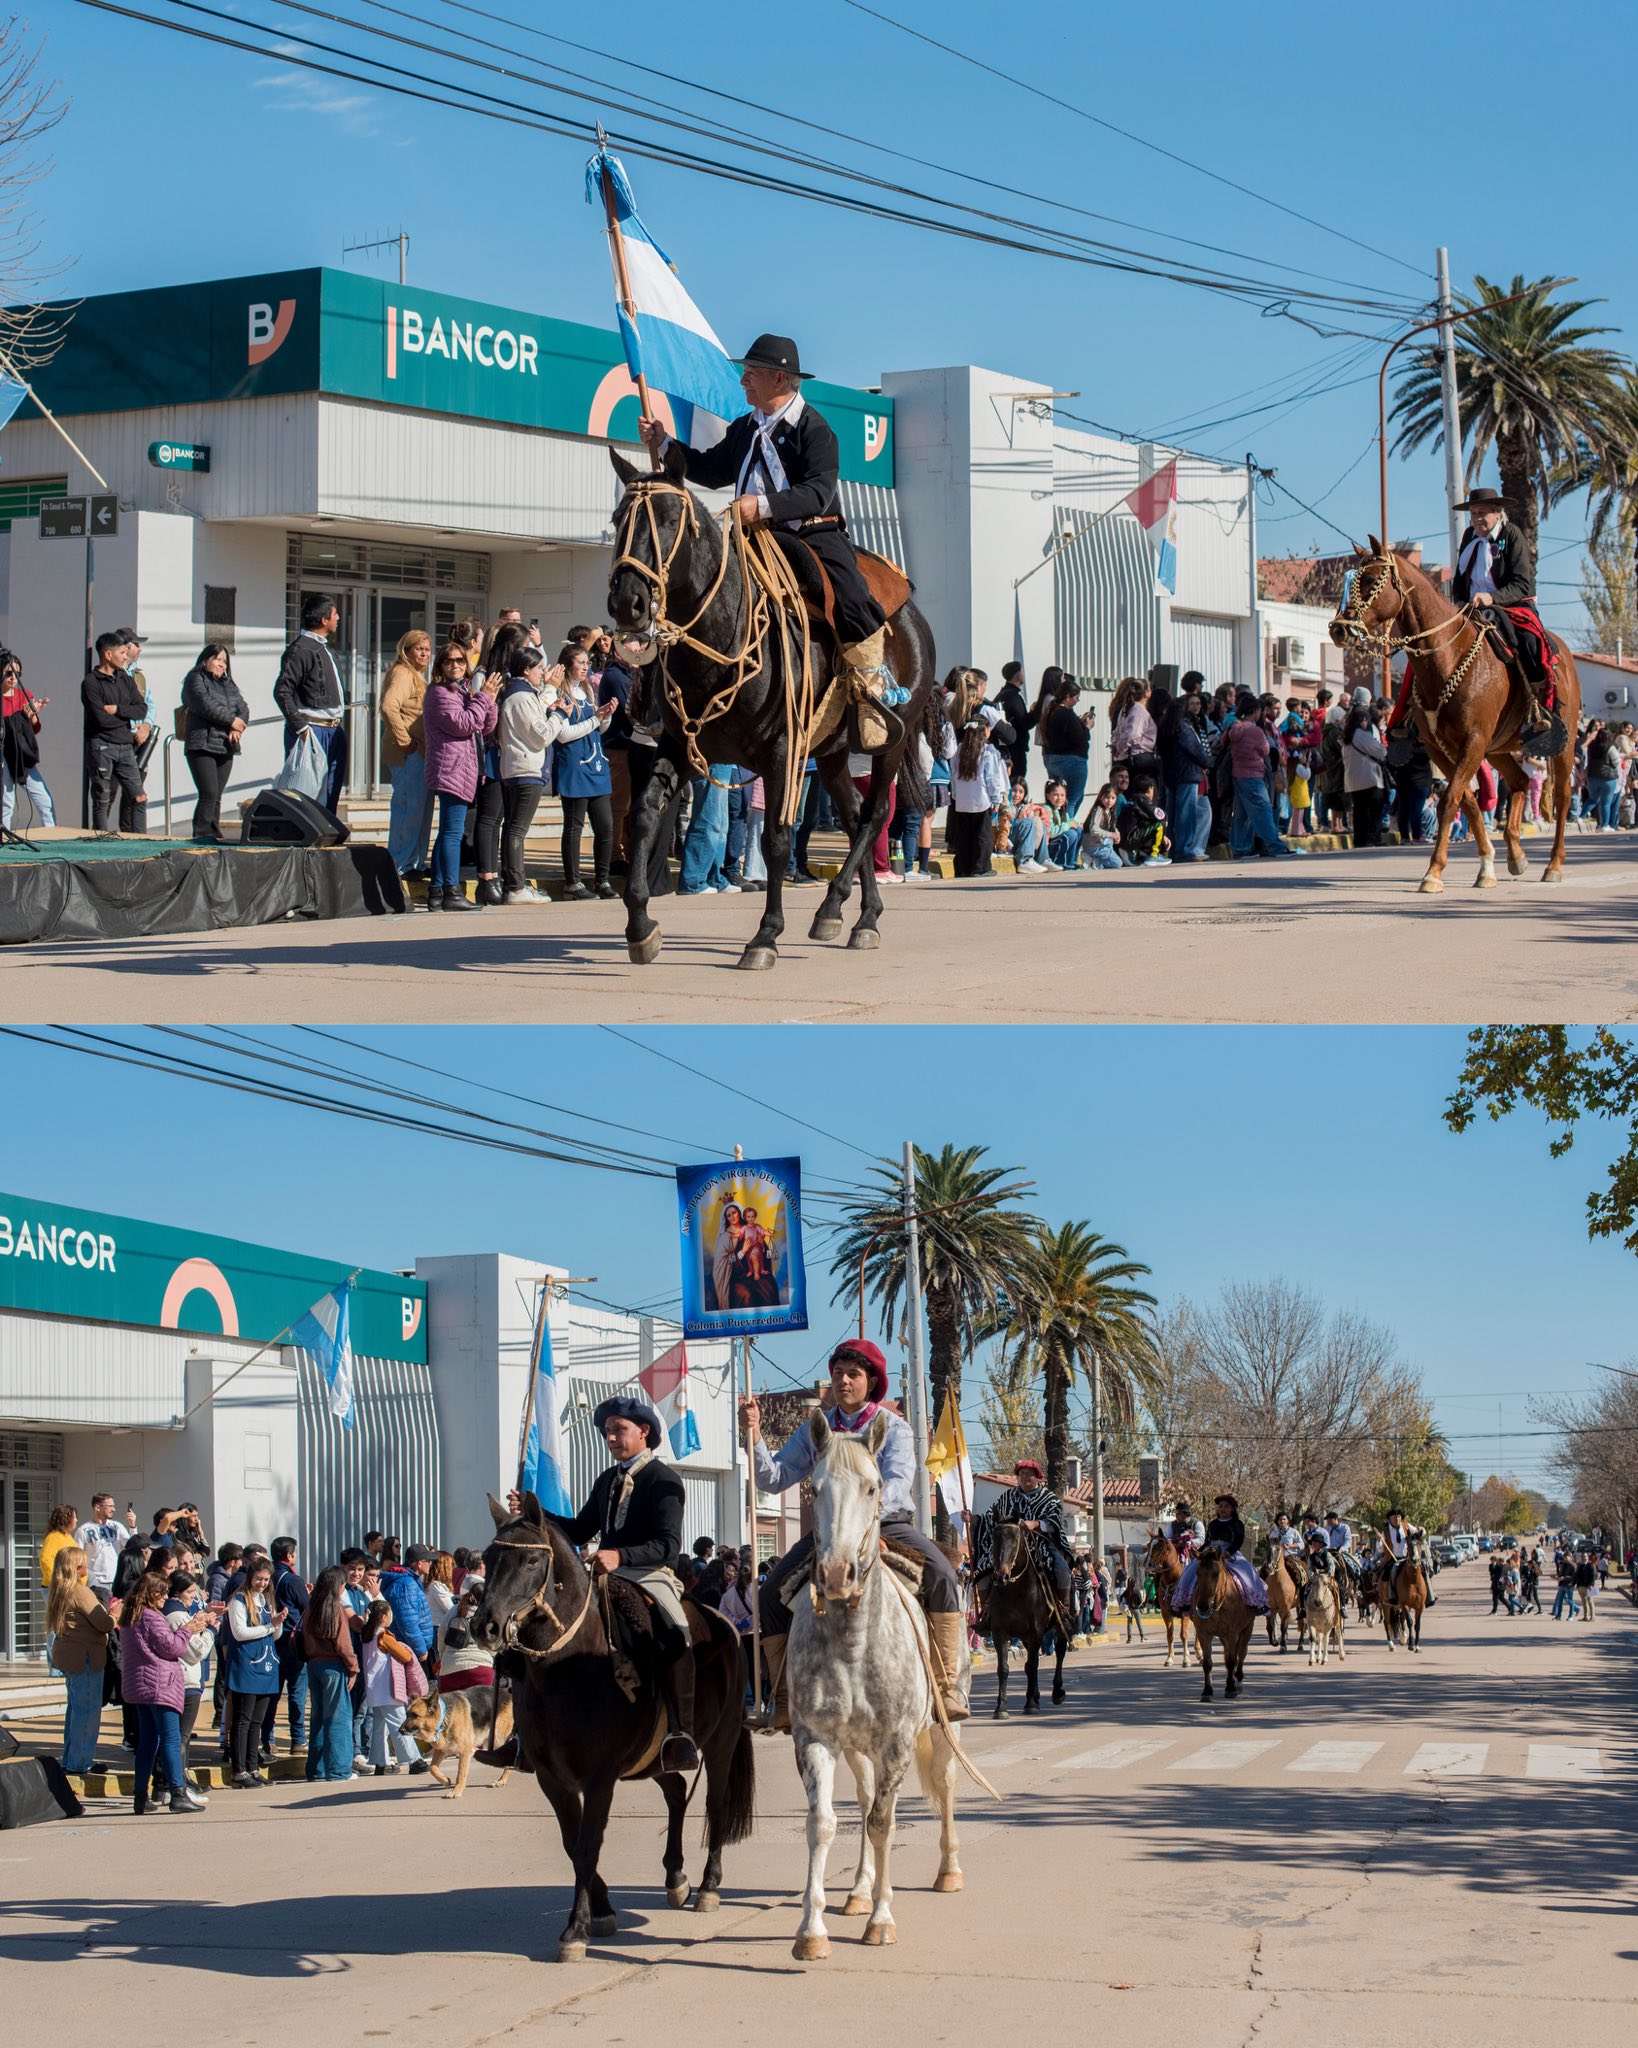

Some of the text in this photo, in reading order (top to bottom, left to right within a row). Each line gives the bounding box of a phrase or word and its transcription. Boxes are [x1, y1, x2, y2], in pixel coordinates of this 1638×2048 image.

[248, 303, 275, 346] B
[403, 309, 538, 376] BANCOR
[864, 414, 878, 447] B
[175, 448, 205, 460] BANCOR
[45, 525, 81, 535] 700 600
[681, 1176, 719, 1236] AGRUPACION
[720, 1168, 756, 1181] VIRGEN
[759, 1170, 775, 1184] DEL
[0, 1215, 116, 1273] BANCOR
[402, 1296, 414, 1327] B
[687, 1319, 725, 1332] Colonia
